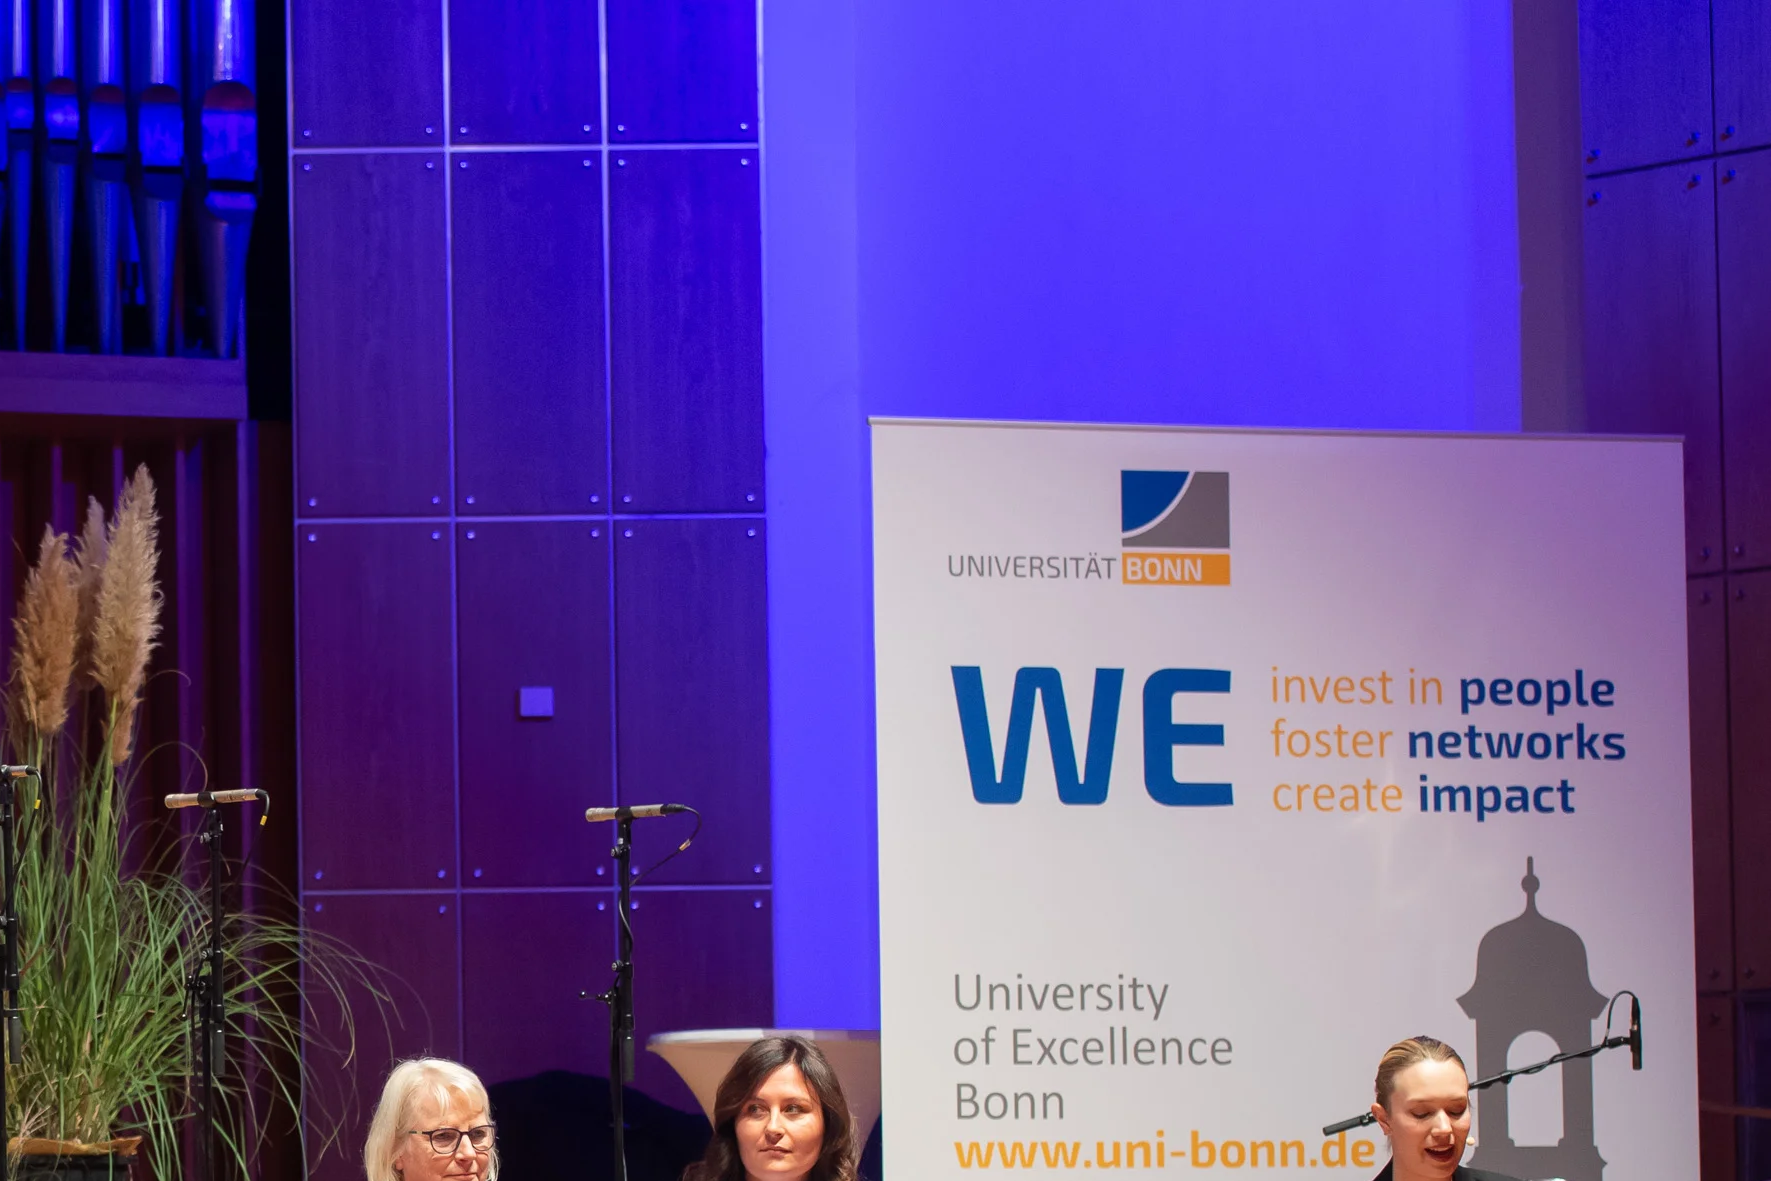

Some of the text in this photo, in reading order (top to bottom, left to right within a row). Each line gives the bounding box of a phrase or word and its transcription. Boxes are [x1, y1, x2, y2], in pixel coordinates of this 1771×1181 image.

[948, 552, 1203, 581] UNIVERSITÄT BONN
[1271, 667, 1615, 716] invest in people
[951, 666, 1234, 806] WE
[1271, 718, 1626, 761] foster networks
[1273, 775, 1576, 822] create impact
[954, 974, 1169, 1020] University
[953, 1026, 1233, 1065] of Excellence
[957, 1083, 1064, 1120] Bonn
[954, 1131, 1376, 1169] www.uni-bonn.de
